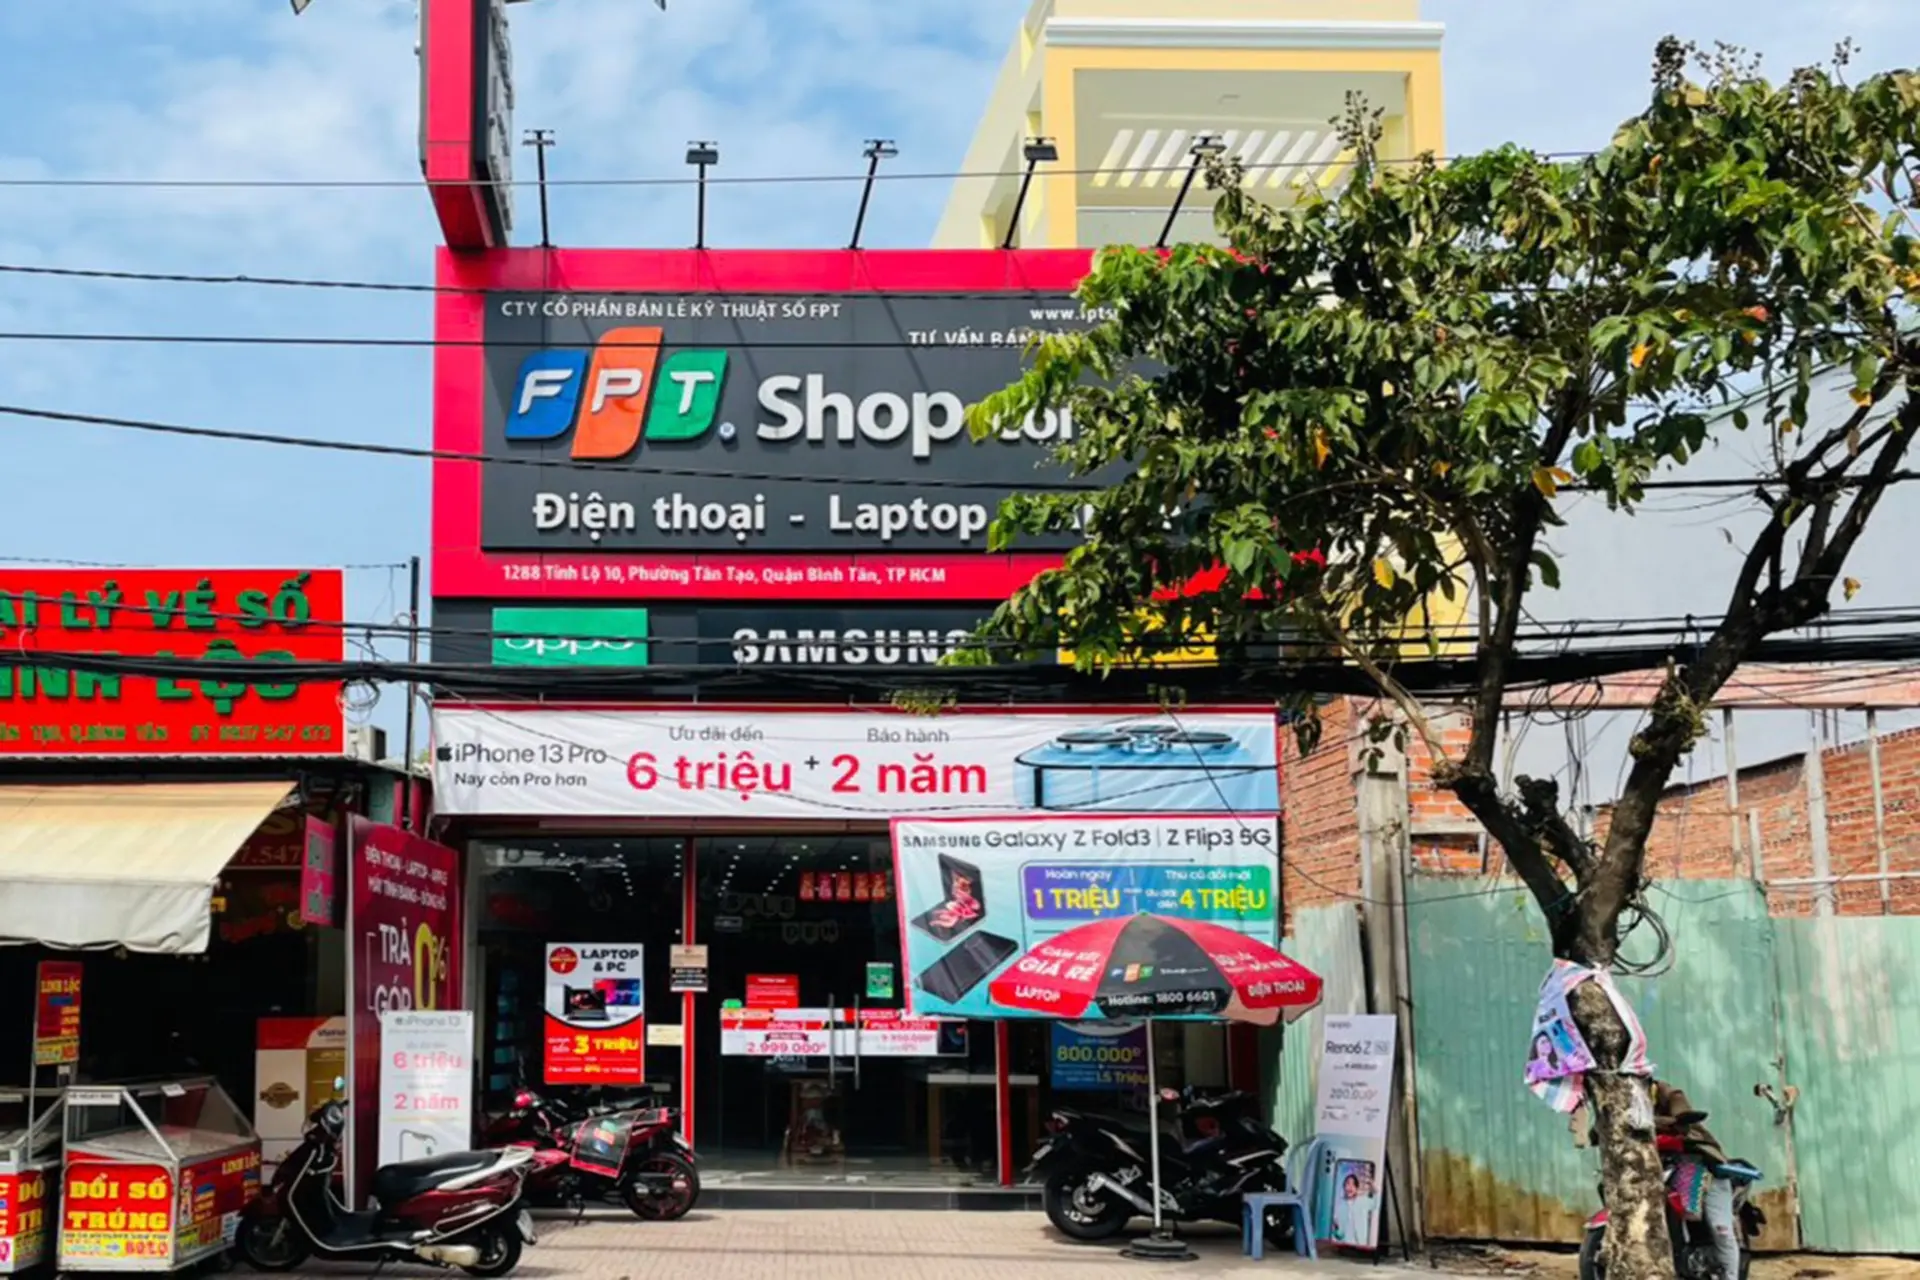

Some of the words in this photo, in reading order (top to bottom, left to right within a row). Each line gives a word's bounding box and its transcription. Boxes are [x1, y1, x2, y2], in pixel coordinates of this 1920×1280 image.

[501, 301, 537, 317] CTY
[626, 298, 663, 317] BÁN
[782, 296, 805, 317] SỐ
[810, 302, 841, 317] FPT
[518, 366, 715, 415] FPT
[533, 492, 635, 542] Điện
[653, 493, 765, 544] thoại
[830, 493, 987, 542] Laptop
[502, 565, 541, 581] 1288
[628, 565, 690, 585] Phường
[693, 565, 723, 582] Tân
[762, 567, 803, 586] Quận
[887, 568, 907, 582] TP
[909, 567, 946, 583] HCM
[144, 578, 217, 629] VÉ
[235, 571, 311, 628] SỐ
[669, 725, 694, 741] Ưu
[699, 726, 726, 742] đãi
[730, 725, 764, 742] đến
[867, 727, 901, 743] Bảo
[905, 728, 950, 744] hành
[455, 743, 535, 764] iPhone
[539, 744, 563, 763] 13
[568, 743, 608, 763] Pro
[454, 772, 484, 788] Nay
[489, 772, 520, 787] còn
[524, 773, 550, 787] Pro
[555, 772, 587, 787] hơn
[626, 751, 659, 791] 6
[674, 750, 792, 802] triệu
[831, 753, 861, 793] 2
[877, 752, 987, 793] năm
[902, 834, 982, 848] SAMSUNG
[985, 830, 1068, 853] Galaxy
[1074, 830, 1087, 847] Z
[1093, 828, 1152, 847] Fold3
[1166, 829, 1180, 846] Z
[1185, 827, 1235, 852] Flip3
[1240, 827, 1272, 847] 5G
[1033, 887, 1044, 910] 1
[1050, 883, 1121, 916] TRIỆU
[1179, 888, 1196, 910] 4
[1197, 883, 1267, 916] TRIỆU
[378, 916, 412, 966] TRẢ
[580, 948, 640, 961] LAPTOP
[606, 961, 627, 973] PC
[1018, 955, 1065, 978] GIÁ
[1015, 984, 1061, 1003] LAPTOP
[572, 1034, 589, 1055] 3
[128, 1174, 168, 1200] SỐ
